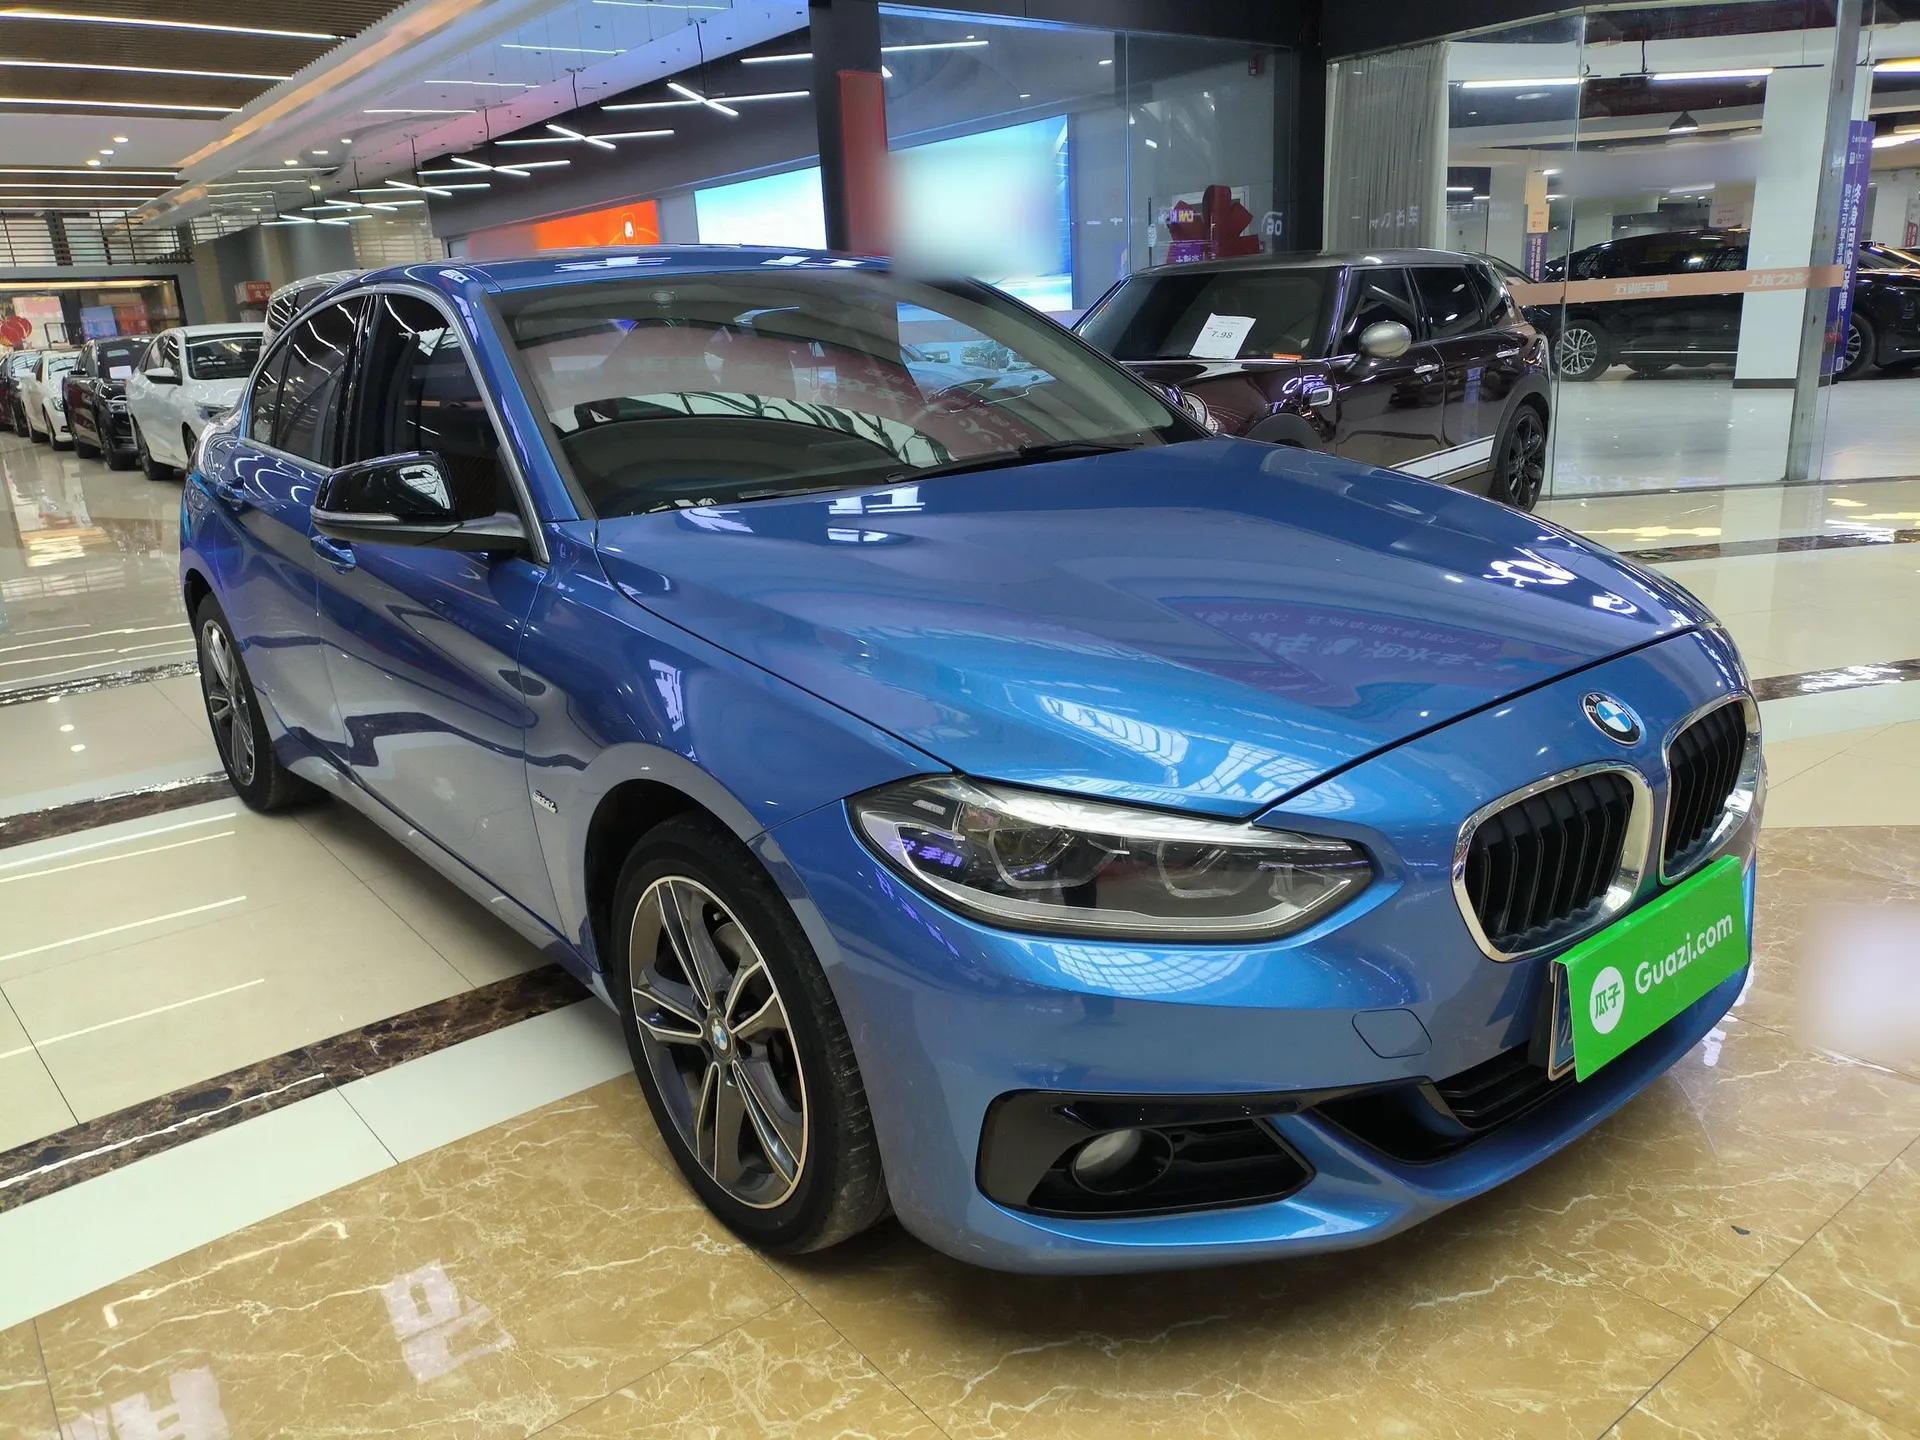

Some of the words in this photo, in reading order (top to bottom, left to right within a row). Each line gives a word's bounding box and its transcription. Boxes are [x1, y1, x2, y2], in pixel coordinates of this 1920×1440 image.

[1211, 330, 1234, 340] 7.98
[1635, 914, 1733, 994] Guazi.com
[1595, 982, 1621, 1019] 瓜子
